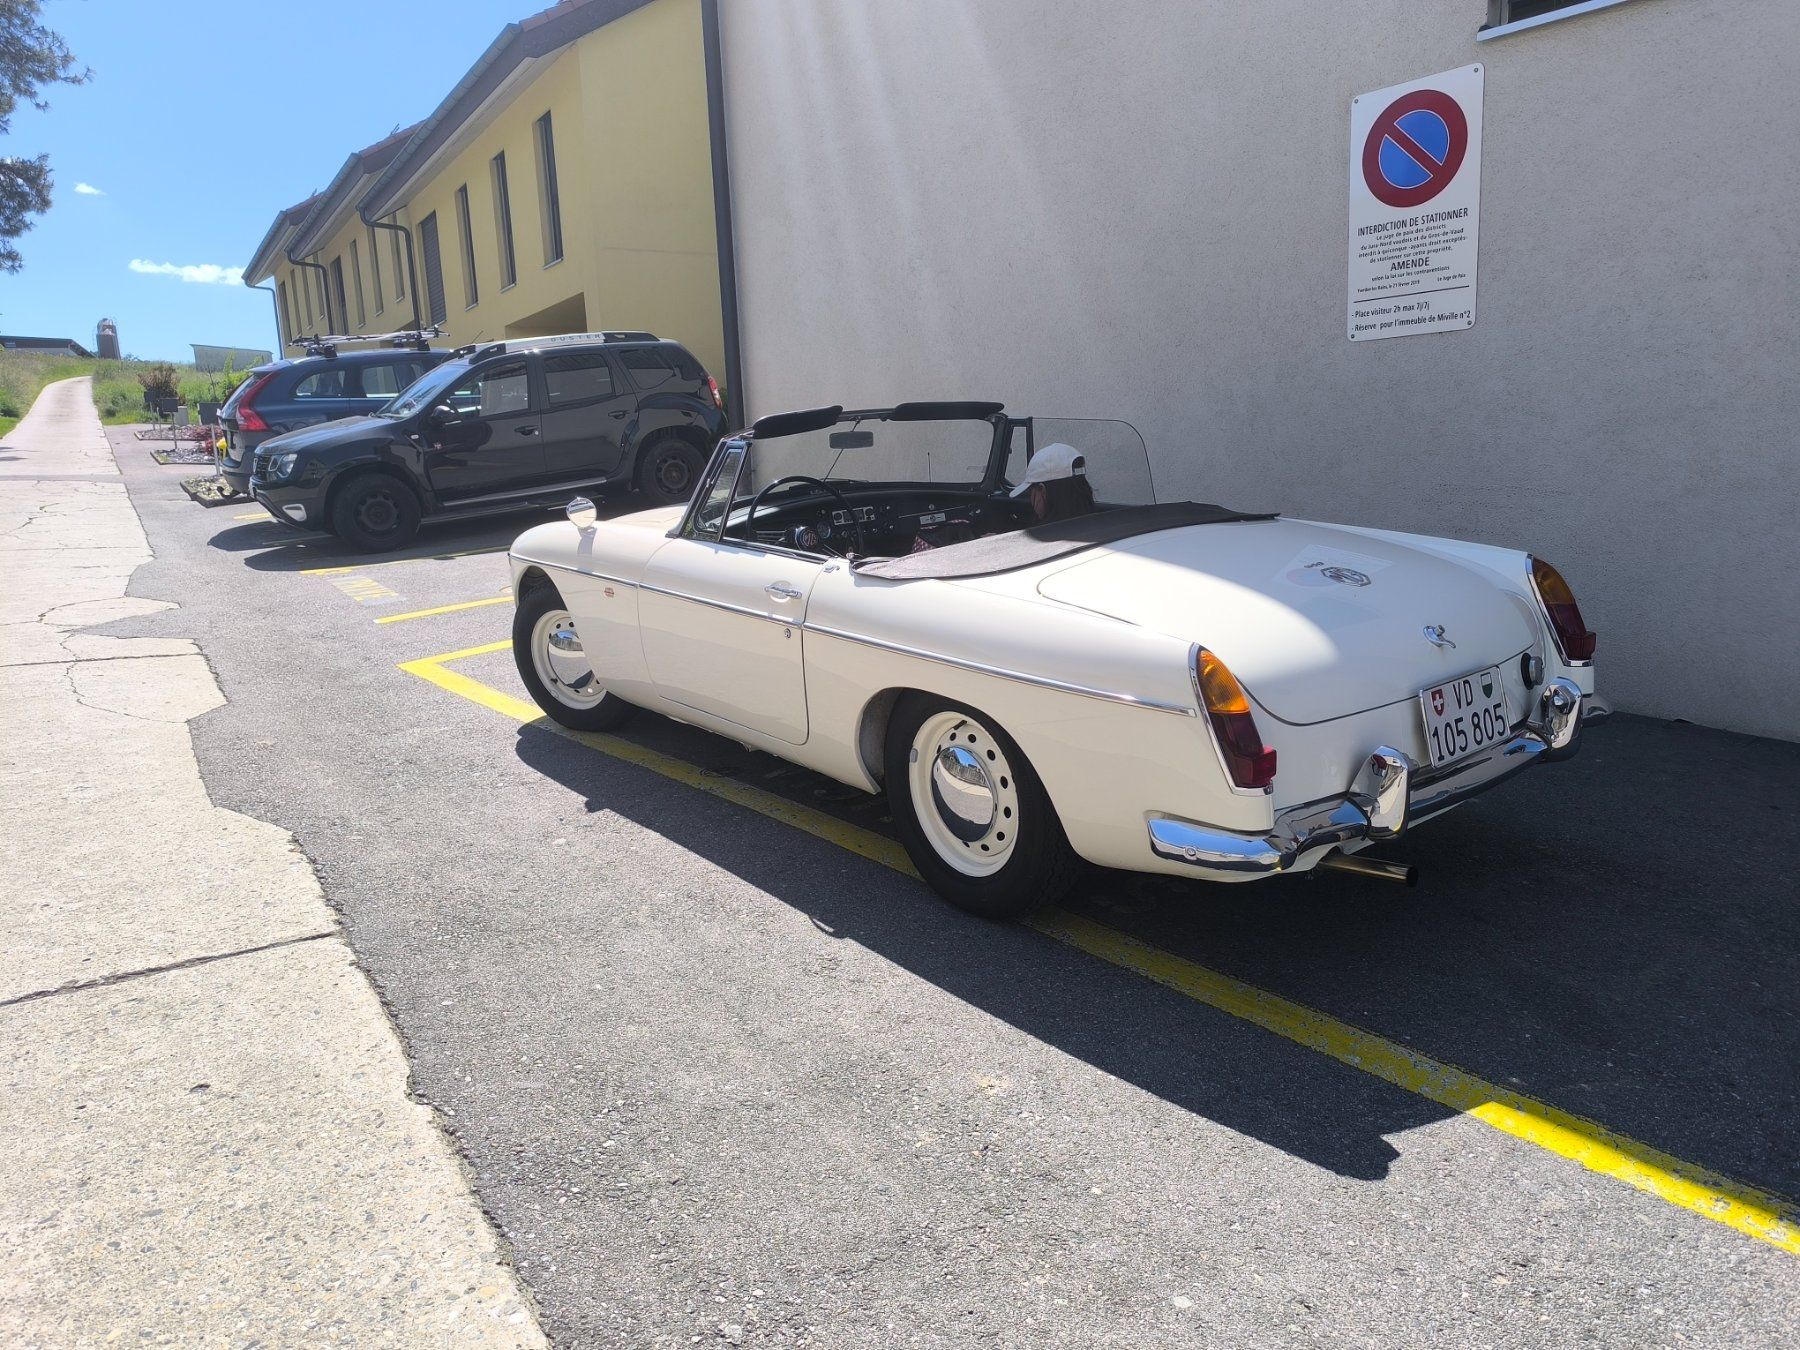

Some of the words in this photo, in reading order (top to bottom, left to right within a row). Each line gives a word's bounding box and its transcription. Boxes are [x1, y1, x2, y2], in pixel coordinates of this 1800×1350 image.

[1358, 219, 1408, 237] INTERDICTION
[1410, 216, 1419, 227] DE
[1421, 208, 1468, 225] STATIONNER
[1425, 224, 1446, 232] districts
[1358, 250, 1376, 258] interdit
[1390, 257, 1430, 271] AMENDE
[1355, 308, 1370, 318] Place
[1371, 306, 1392, 315] visiteur
[1393, 305, 1401, 313] 2h
[1416, 301, 1430, 312] 7j/7j
[1355, 322, 1377, 332] Réserve
[1380, 321, 1393, 330] pour
[1394, 316, 1426, 327] l'immeuble
[1437, 312, 1458, 322] Miville
[1459, 310, 1471, 320] n°2
[550, 334, 601, 342] DUSTER
[803, 532, 818, 546] MG
[1453, 679, 1473, 710] VD
